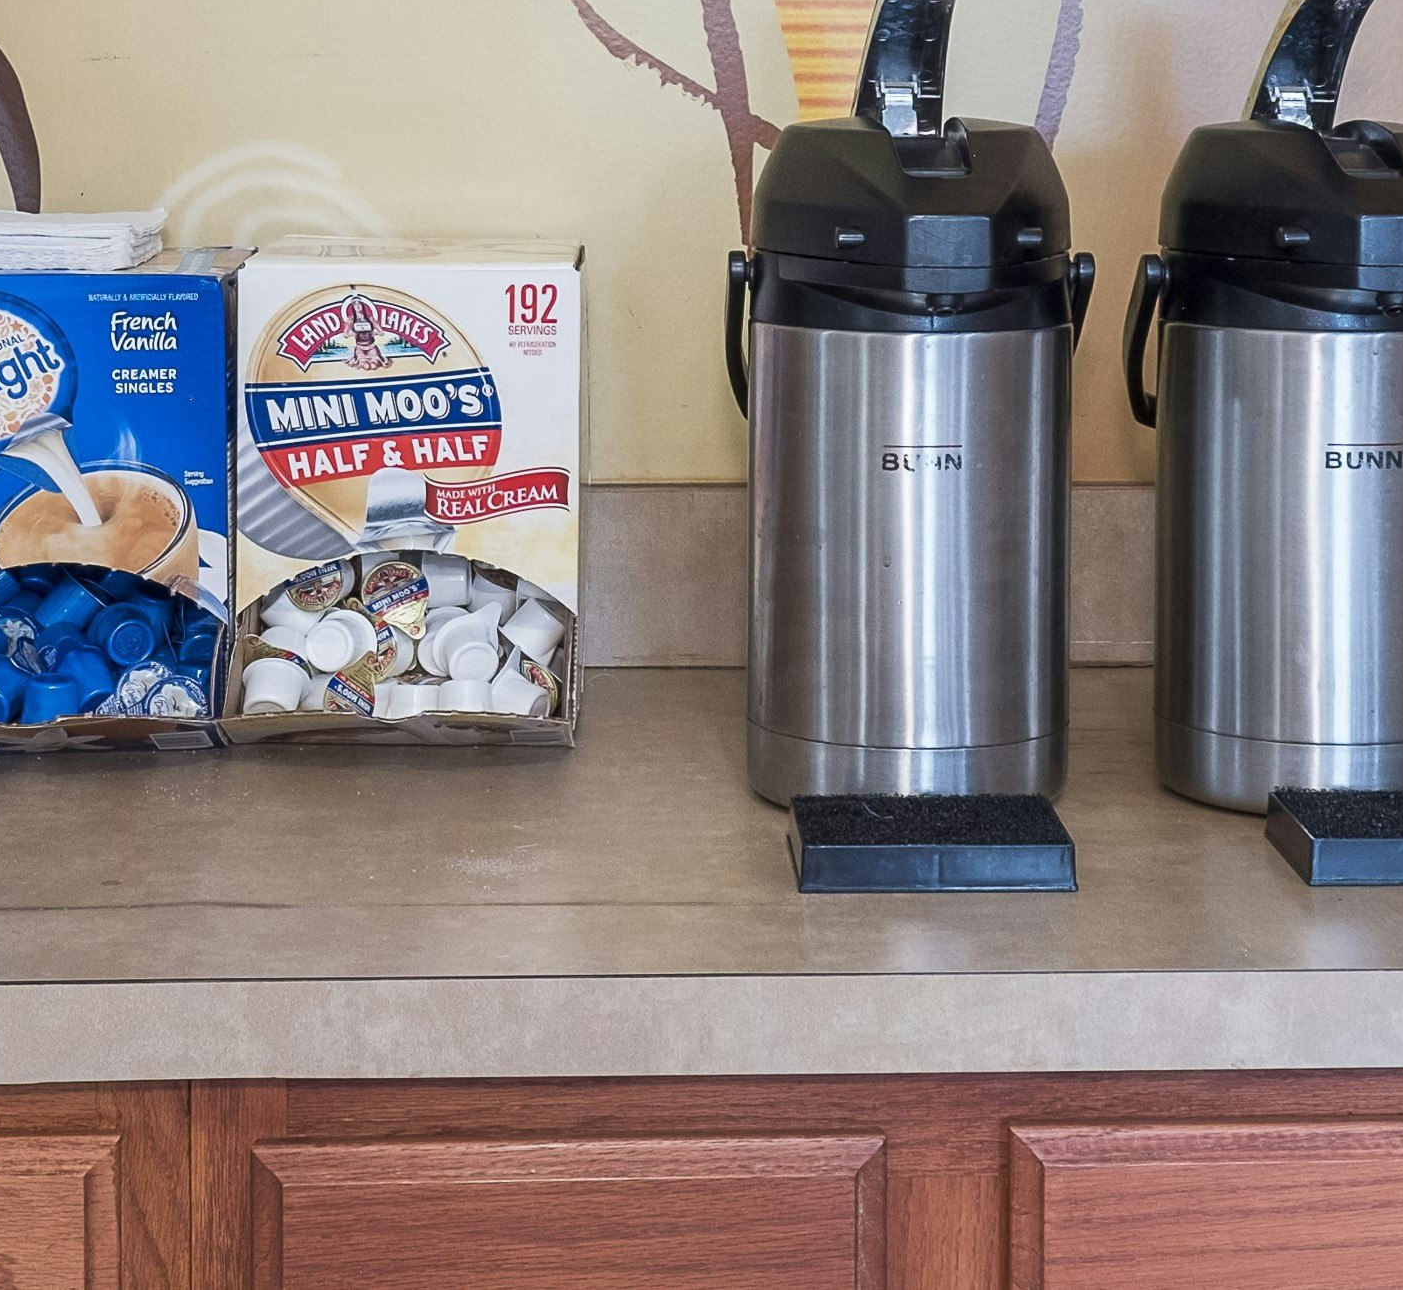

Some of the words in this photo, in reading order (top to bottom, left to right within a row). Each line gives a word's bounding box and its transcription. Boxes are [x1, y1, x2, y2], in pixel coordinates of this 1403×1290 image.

[88, 293, 122, 302] NATURALLY
[129, 293, 167, 302] ARTIFICIALLY
[168, 292, 199, 301] FLAVORED
[504, 283, 559, 325] 192
[111, 310, 178, 331] French
[290, 312, 342, 352] LAND
[380, 307, 434, 345] LAKES
[507, 325, 558, 336] SERVINGS
[111, 331, 178, 352] Vanilla
[111, 368, 178, 381] CREAMER
[114, 382, 175, 394] SINGLES
[265, 395, 358, 434] MINI
[367, 383, 485, 425] MOO'S
[285, 441, 371, 481] HALF
[382, 439, 404, 466] &
[411, 434, 490, 465] HALF
[881, 452, 962, 472] BUN
[1325, 450, 1403, 470] BUNN
[184, 469, 205, 479] Serving
[184, 477, 214, 487] Suggestion
[436, 487, 466, 500] MADE
[467, 484, 497, 498] WITH
[436, 494, 487, 518] REAL
[486, 482, 559, 510] CREAM
[371, 596, 393, 611] MINI
[393, 585, 418, 600] MOO'S
